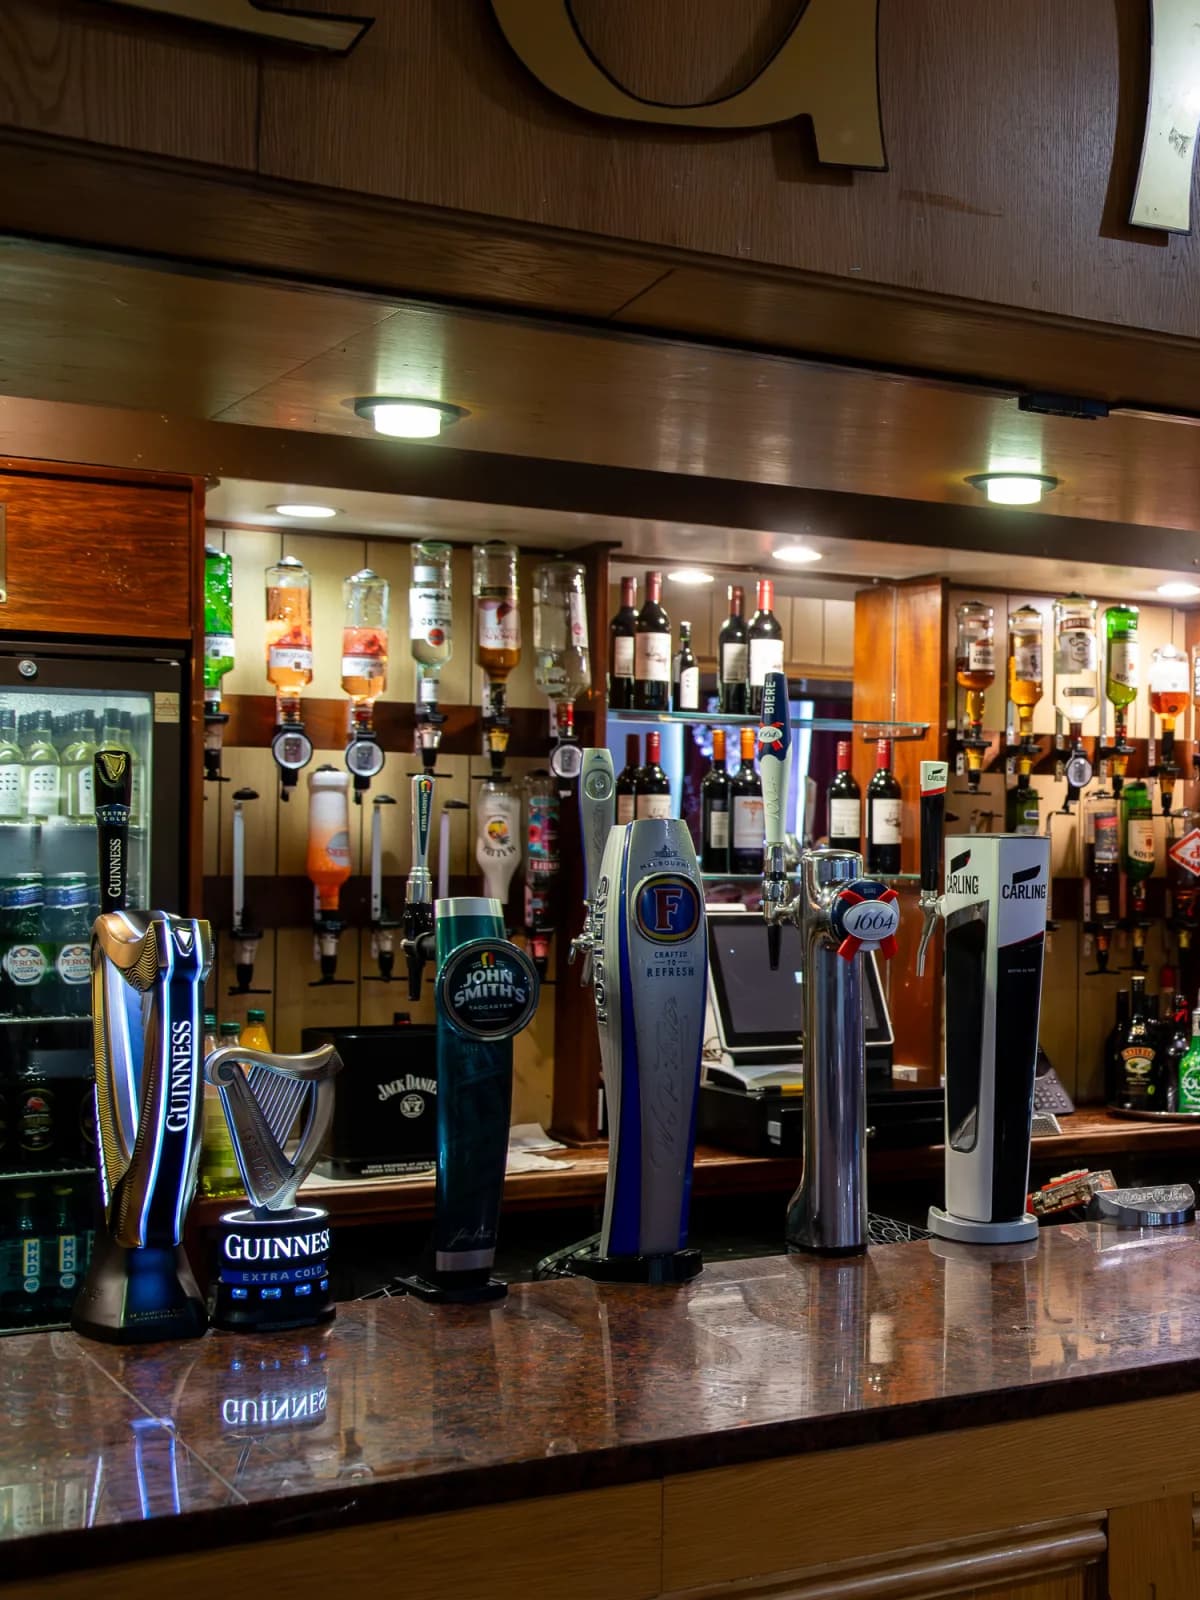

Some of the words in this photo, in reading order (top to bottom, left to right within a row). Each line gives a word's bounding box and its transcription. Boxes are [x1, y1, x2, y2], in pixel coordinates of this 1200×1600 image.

[928, 774, 946, 782] CARLING
[108, 838, 122, 898] GUINNESS
[946, 873, 979, 895] CARLING
[1001, 882, 1047, 900] CARLING
[655, 888, 683, 931] F
[853, 911, 895, 931] 1664
[463, 968, 513, 988] JOHN
[646, 966, 695, 978] REFRESH
[454, 983, 526, 1008] SMITH'S
[165, 1019, 192, 1133] GUINNESS
[242, 1271, 290, 1282] EXTRA
[294, 1264, 323, 1279] COLD
